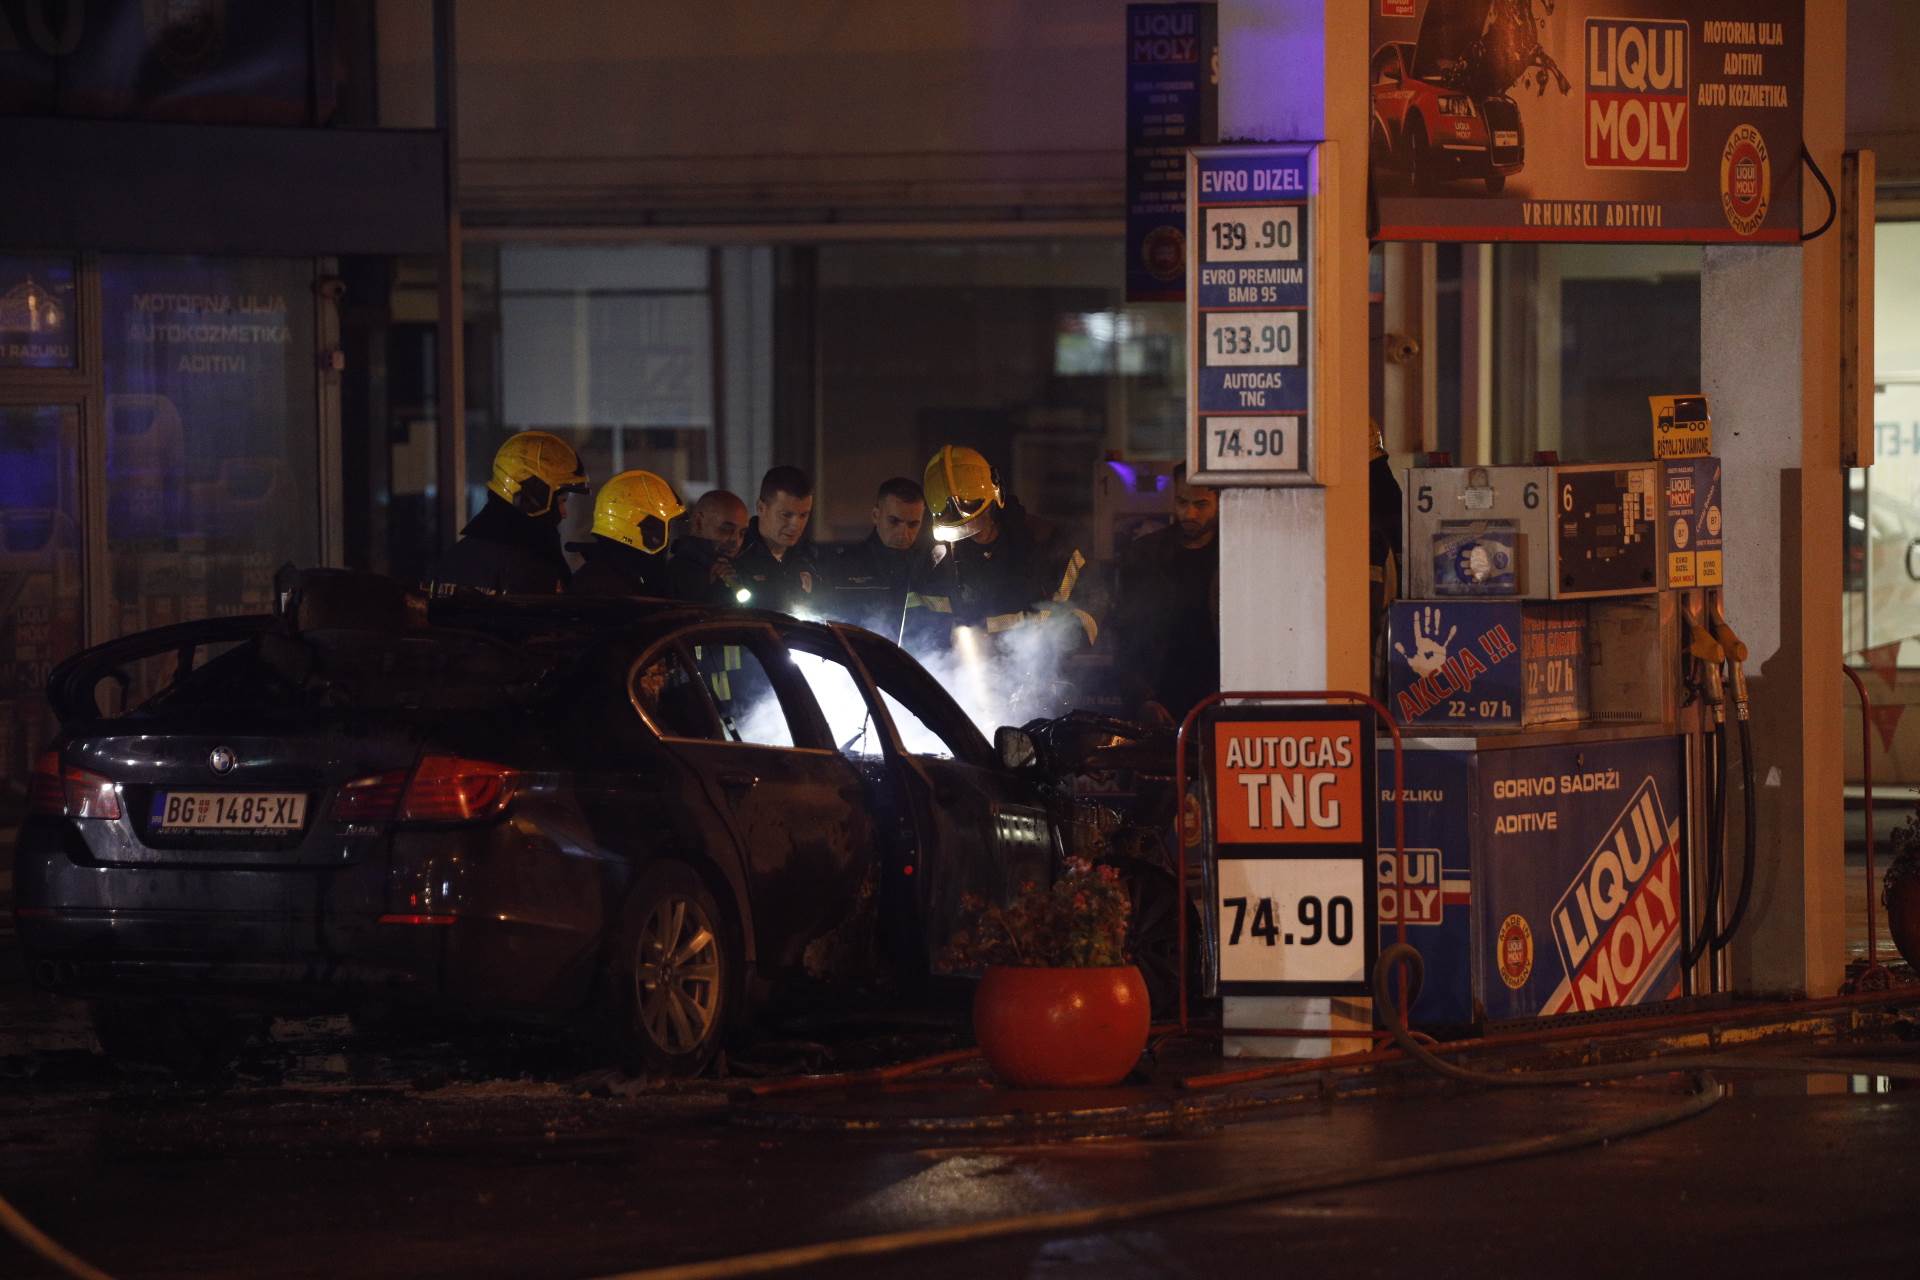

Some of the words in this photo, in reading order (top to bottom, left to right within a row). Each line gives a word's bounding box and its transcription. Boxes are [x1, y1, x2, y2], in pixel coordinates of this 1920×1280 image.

[1134, 13, 1195, 36] LIQUI
[1704, 21, 1755, 44] MOTORNA
[1759, 23, 1784, 45] ULJA
[1134, 40, 1195, 60] MOLY
[1590, 26, 1684, 92] LIQUI
[1724, 53, 1763, 76] ADITIVI
[1698, 83, 1727, 107] AUTO
[1729, 84, 1788, 108] KOZMETIKA
[1590, 99, 1686, 161] MOLY
[1725, 128, 1756, 162] MADE
[1202, 170, 1248, 192] EVRO
[1253, 168, 1304, 191] DIZEL
[1736, 165, 1755, 180] LIQUI
[1736, 181, 1755, 193] MOLY
[1523, 203, 1598, 226] VRHUNSKI
[1606, 204, 1662, 227] ADITIVI
[1723, 193, 1767, 232] GERMANY
[1203, 268, 1235, 285] EVRO
[1239, 267, 1303, 284] PREMIUM
[1228, 287, 1258, 302] BMB
[1261, 286, 1277, 302] 95
[1213, 325, 1291, 354] 133.90
[179, 355, 246, 373] ADITIVI
[1223, 373, 1282, 389] AUTOGAS
[1240, 391, 1265, 407] TNG
[1214, 429, 1284, 457] 74.90
[1523, 483, 1539, 509] 6
[1562, 483, 1573, 511] 6
[1671, 480, 1690, 492] LIQUI
[1417, 486, 1433, 513] 5
[1397, 648, 1488, 724] AKCIJA
[1478, 624, 1518, 664] !!!
[1547, 660, 1562, 693] 07
[1565, 658, 1574, 692] h
[1448, 701, 1466, 717] 22
[1479, 700, 1499, 717] 07
[1502, 700, 1511, 717] h
[1226, 736, 1352, 769] AUTOGAS
[1493, 776, 1555, 799] GORIVO
[1560, 768, 1620, 793] SADRŽI
[167, 797, 195, 823] BG
[1238, 772, 1341, 828] TNG
[1494, 811, 1558, 834] ADITIVE
[1558, 791, 1663, 969] LIQUI
[1223, 895, 1353, 946] 74.90
[1578, 851, 1679, 1012] MOLY
